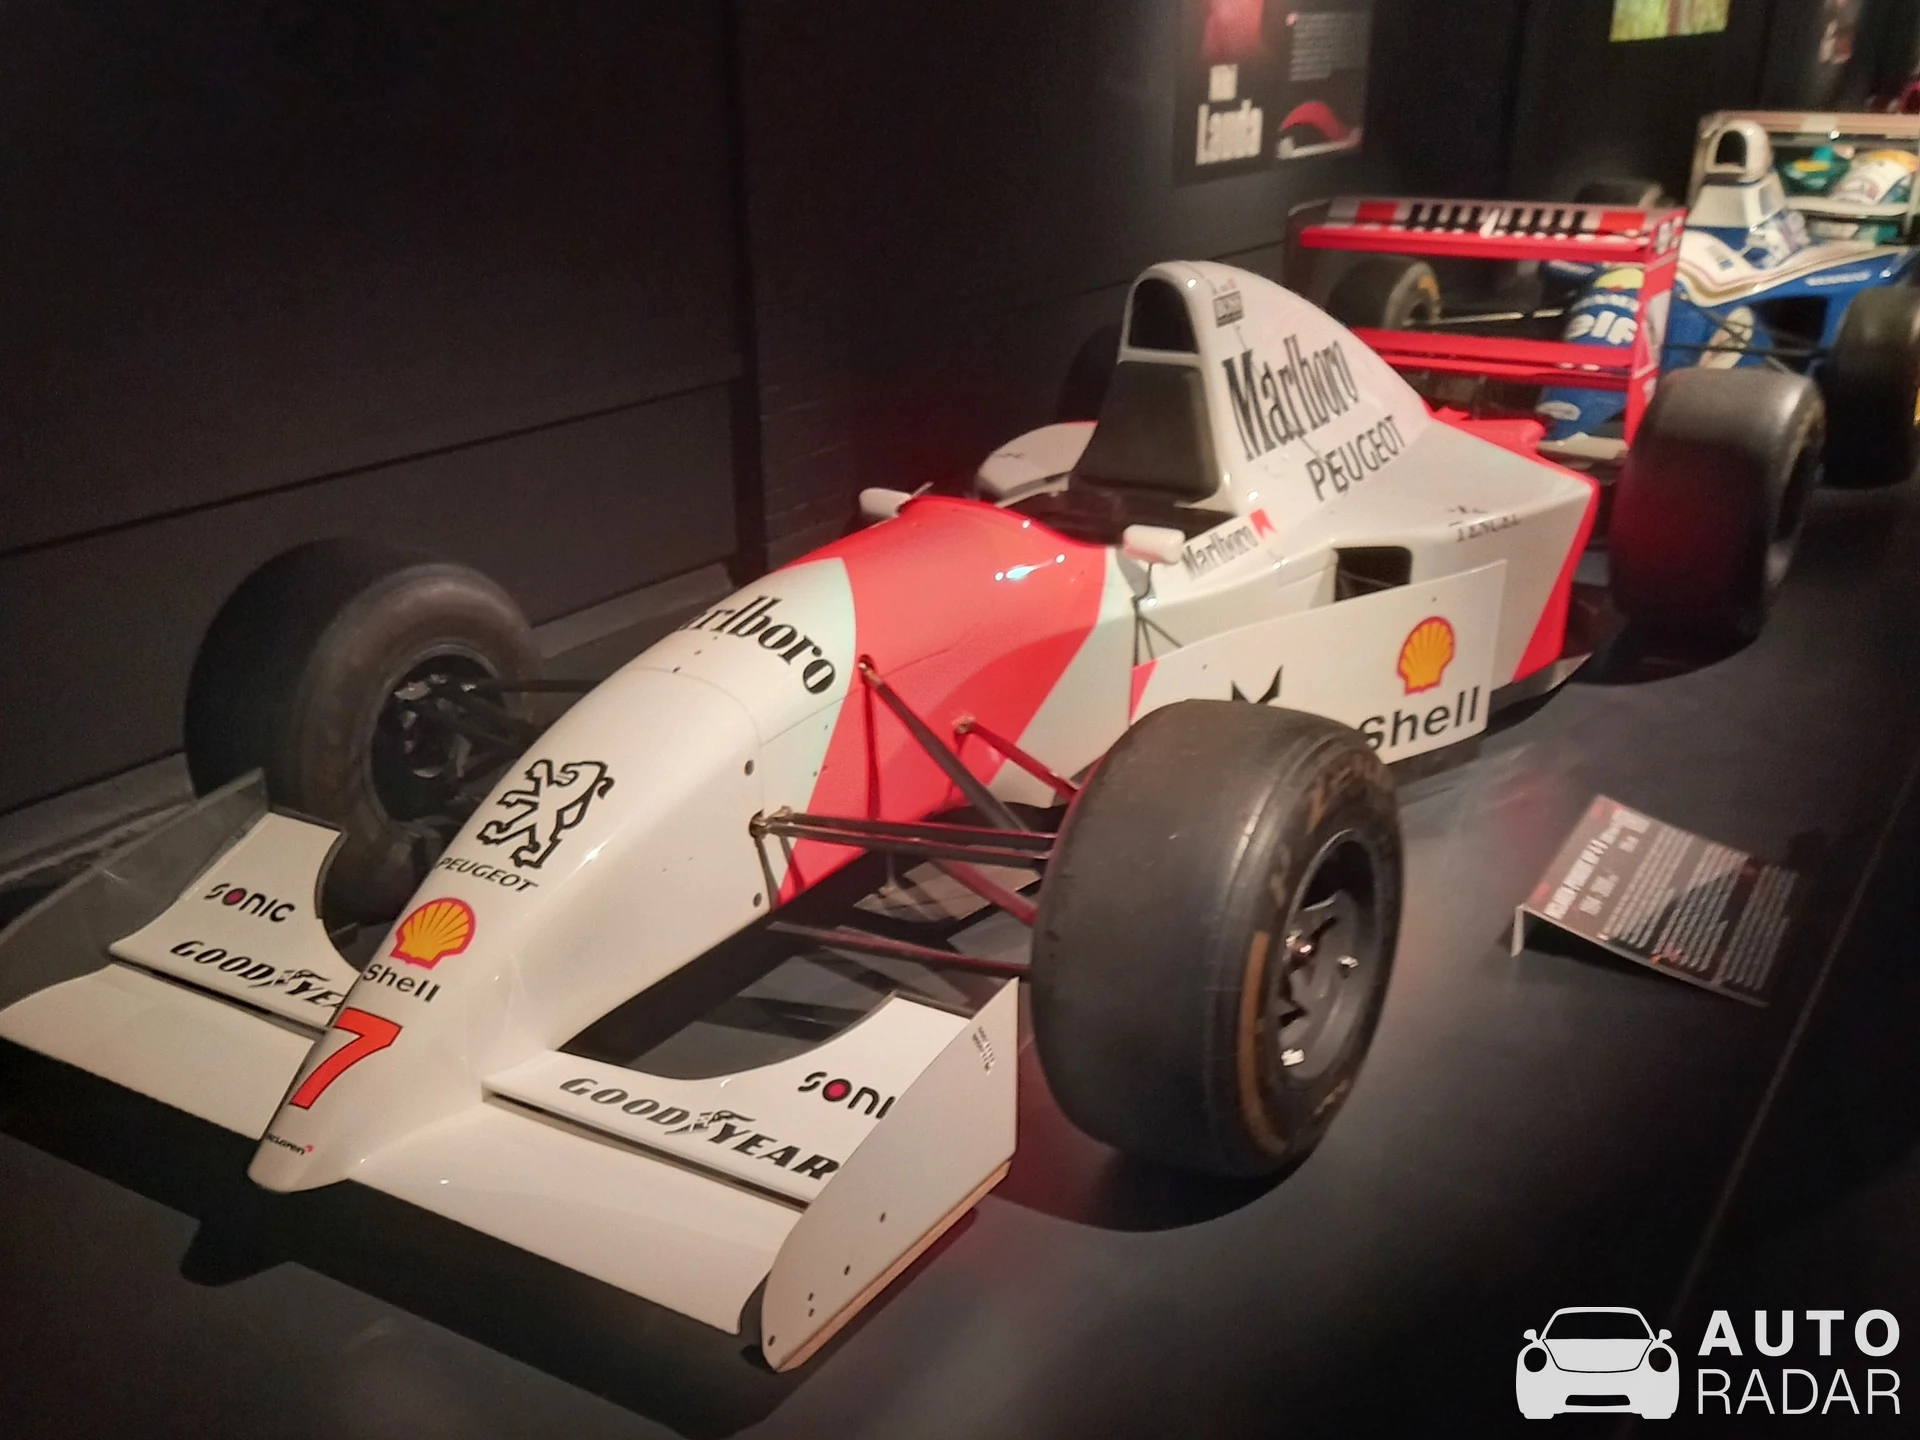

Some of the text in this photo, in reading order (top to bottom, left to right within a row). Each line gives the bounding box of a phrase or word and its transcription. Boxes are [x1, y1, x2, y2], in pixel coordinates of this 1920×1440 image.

[1222, 334, 1359, 462] Marlboro
[1305, 415, 1407, 502] PEUGEOT
[1181, 523, 1259, 579] Marlboro
[680, 595, 836, 695] rlboro
[1357, 686, 1481, 752] Shell
[437, 857, 539, 893] PEUGEOT
[170, 940, 345, 1007] GOODYE
[362, 963, 441, 1003] Shell
[288, 1006, 403, 1110] 7
